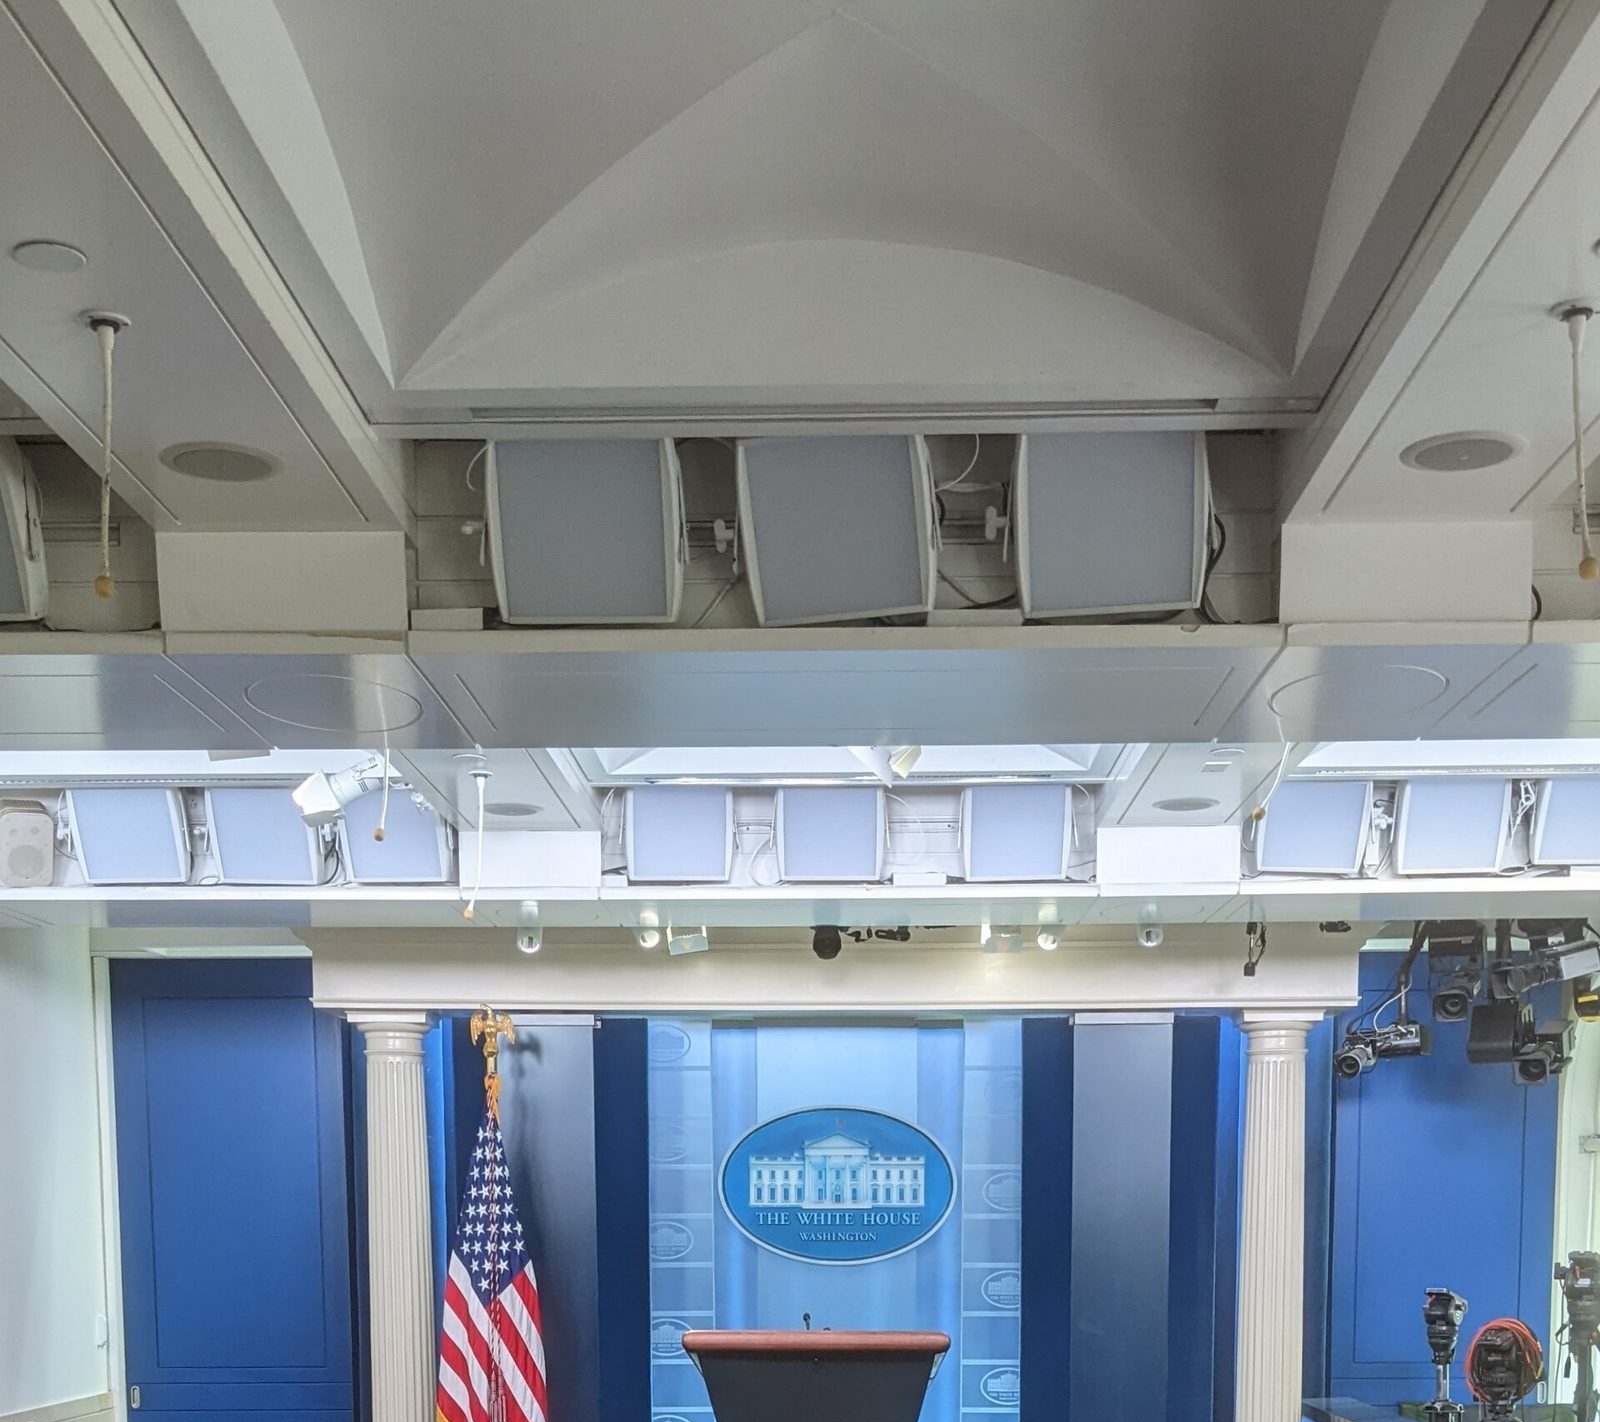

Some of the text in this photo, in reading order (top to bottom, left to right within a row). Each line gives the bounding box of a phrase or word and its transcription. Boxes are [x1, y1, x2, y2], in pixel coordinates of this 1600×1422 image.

[756, 1212, 921, 1225] THE WHITE HOUSE
[800, 1232, 878, 1241] WASHINGTON
